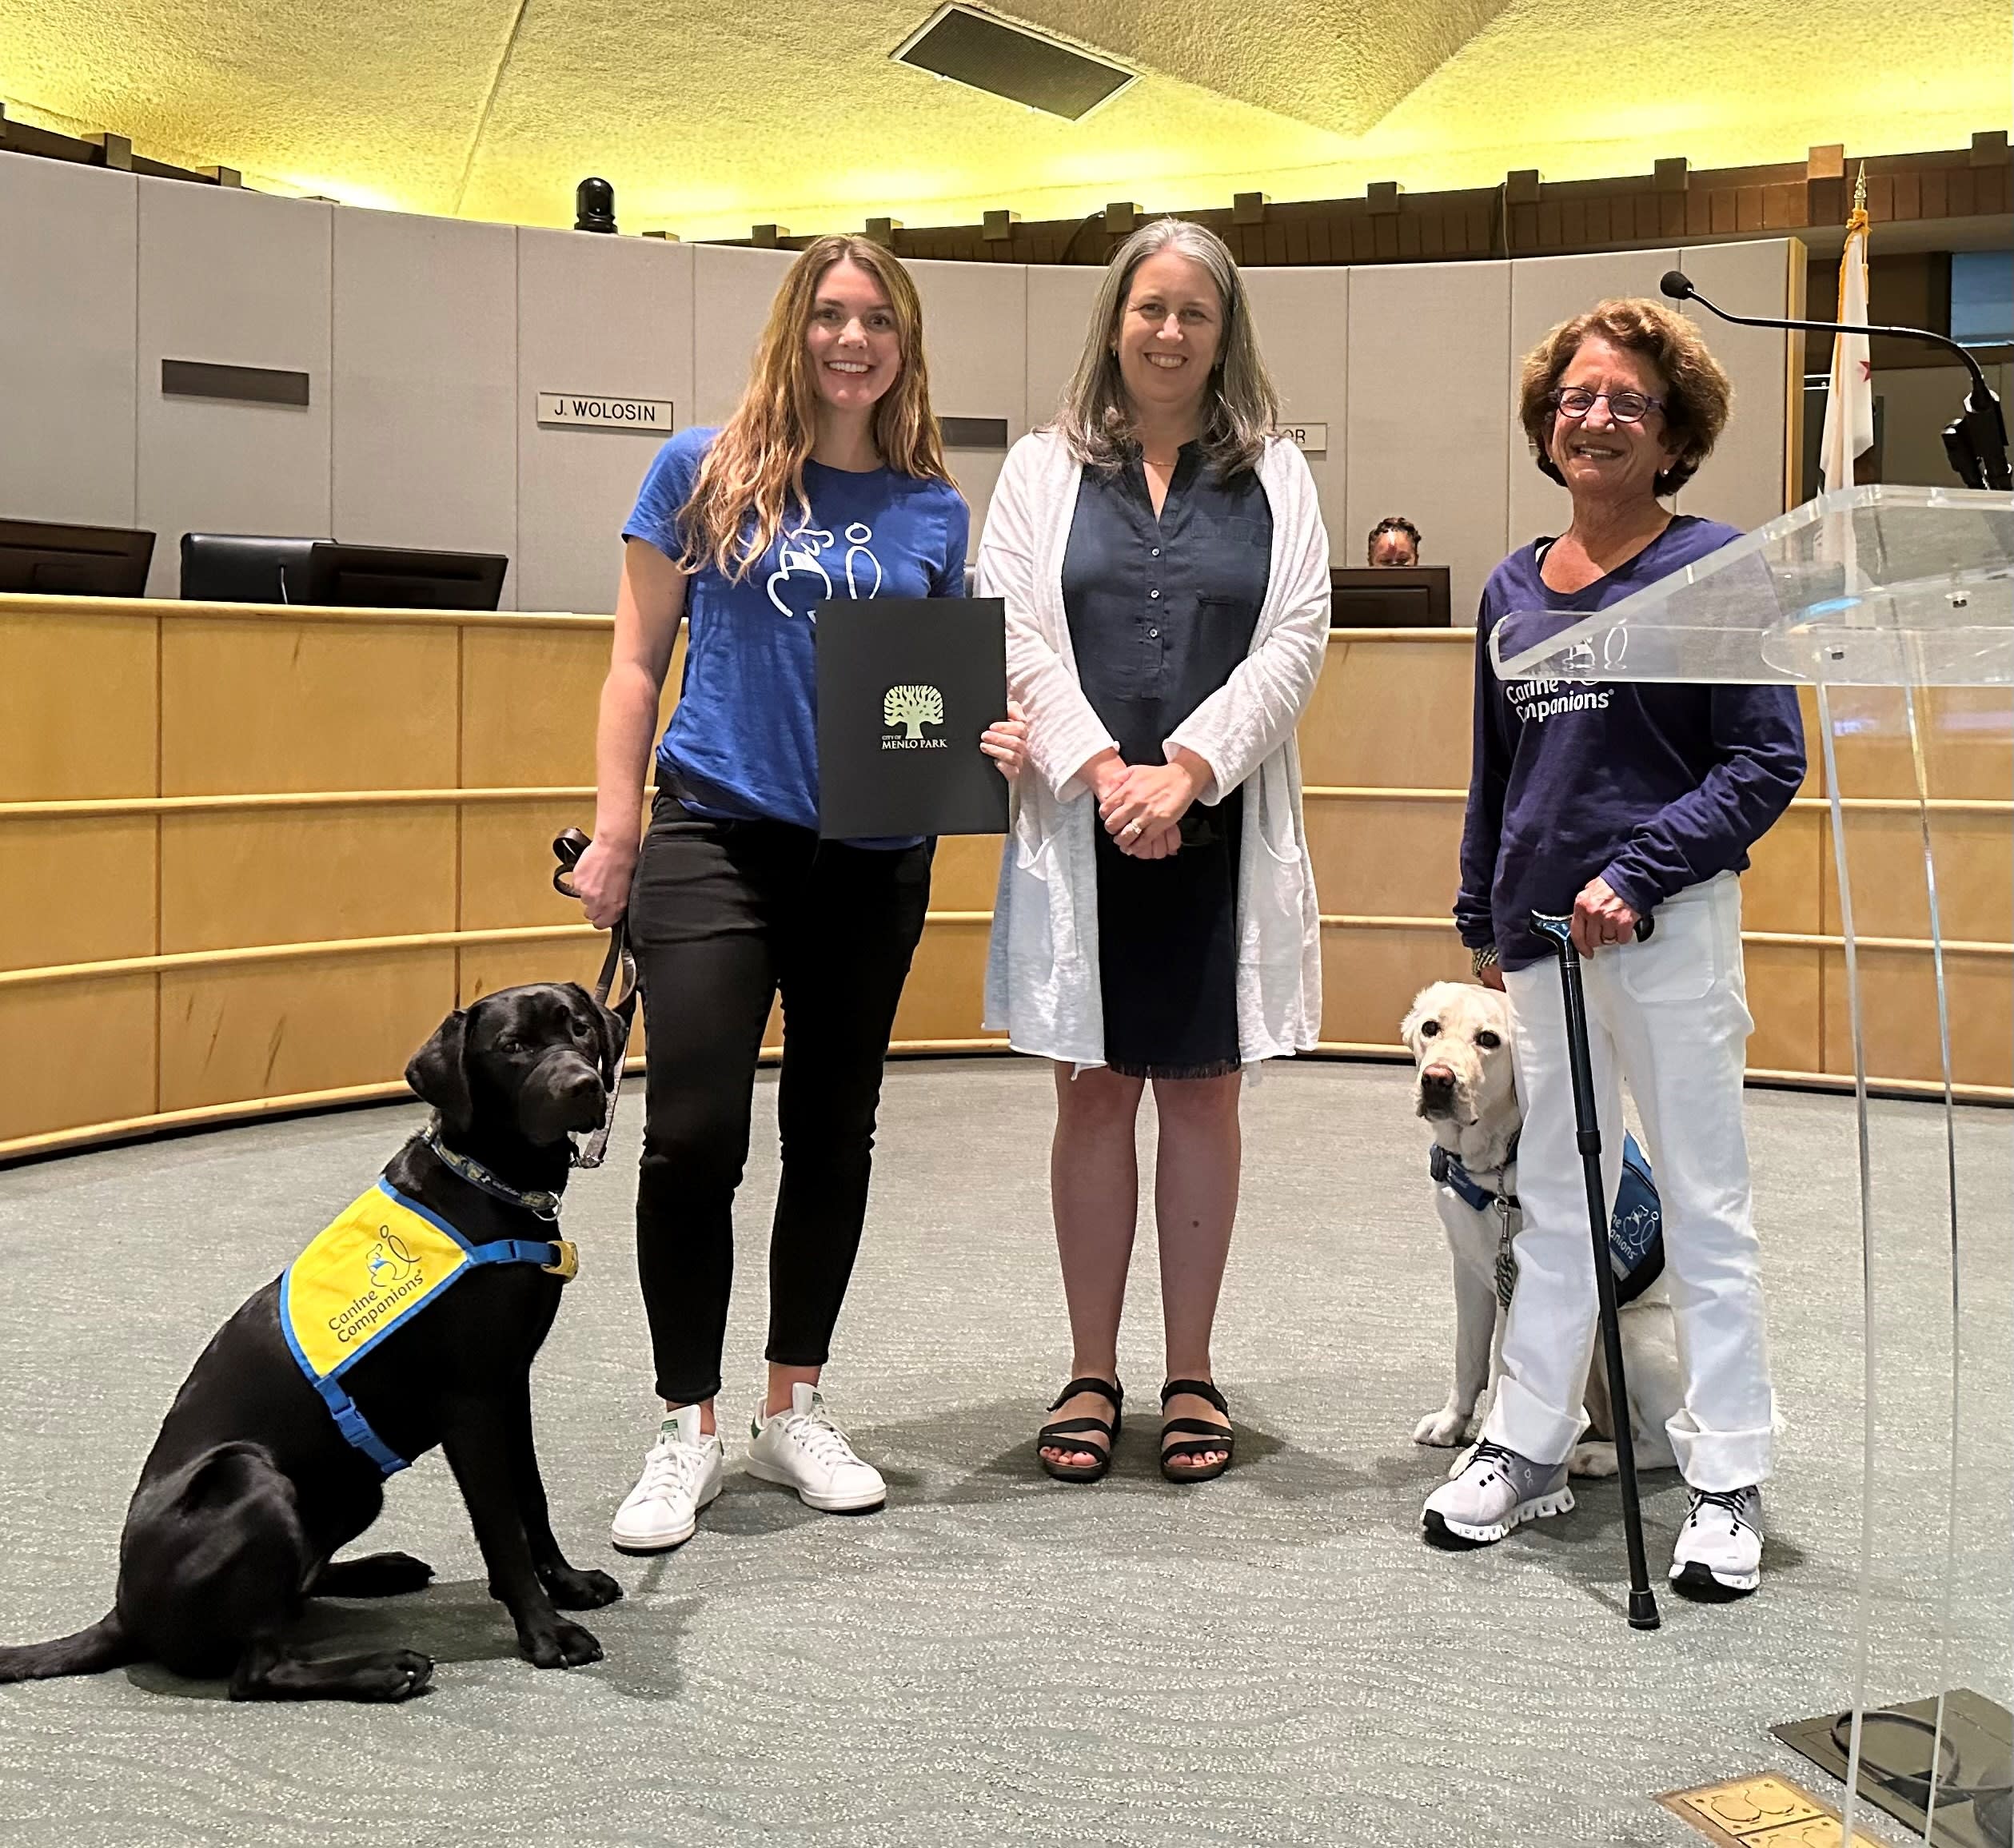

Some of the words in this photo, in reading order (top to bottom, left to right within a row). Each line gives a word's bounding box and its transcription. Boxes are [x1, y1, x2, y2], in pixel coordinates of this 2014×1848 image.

[554, 399, 568, 416] J.
[572, 400, 656, 422] WOLOSIN
[881, 739, 918, 750] MENLO
[919, 739, 948, 749] PARK
[328, 1289, 379, 1331] Canine
